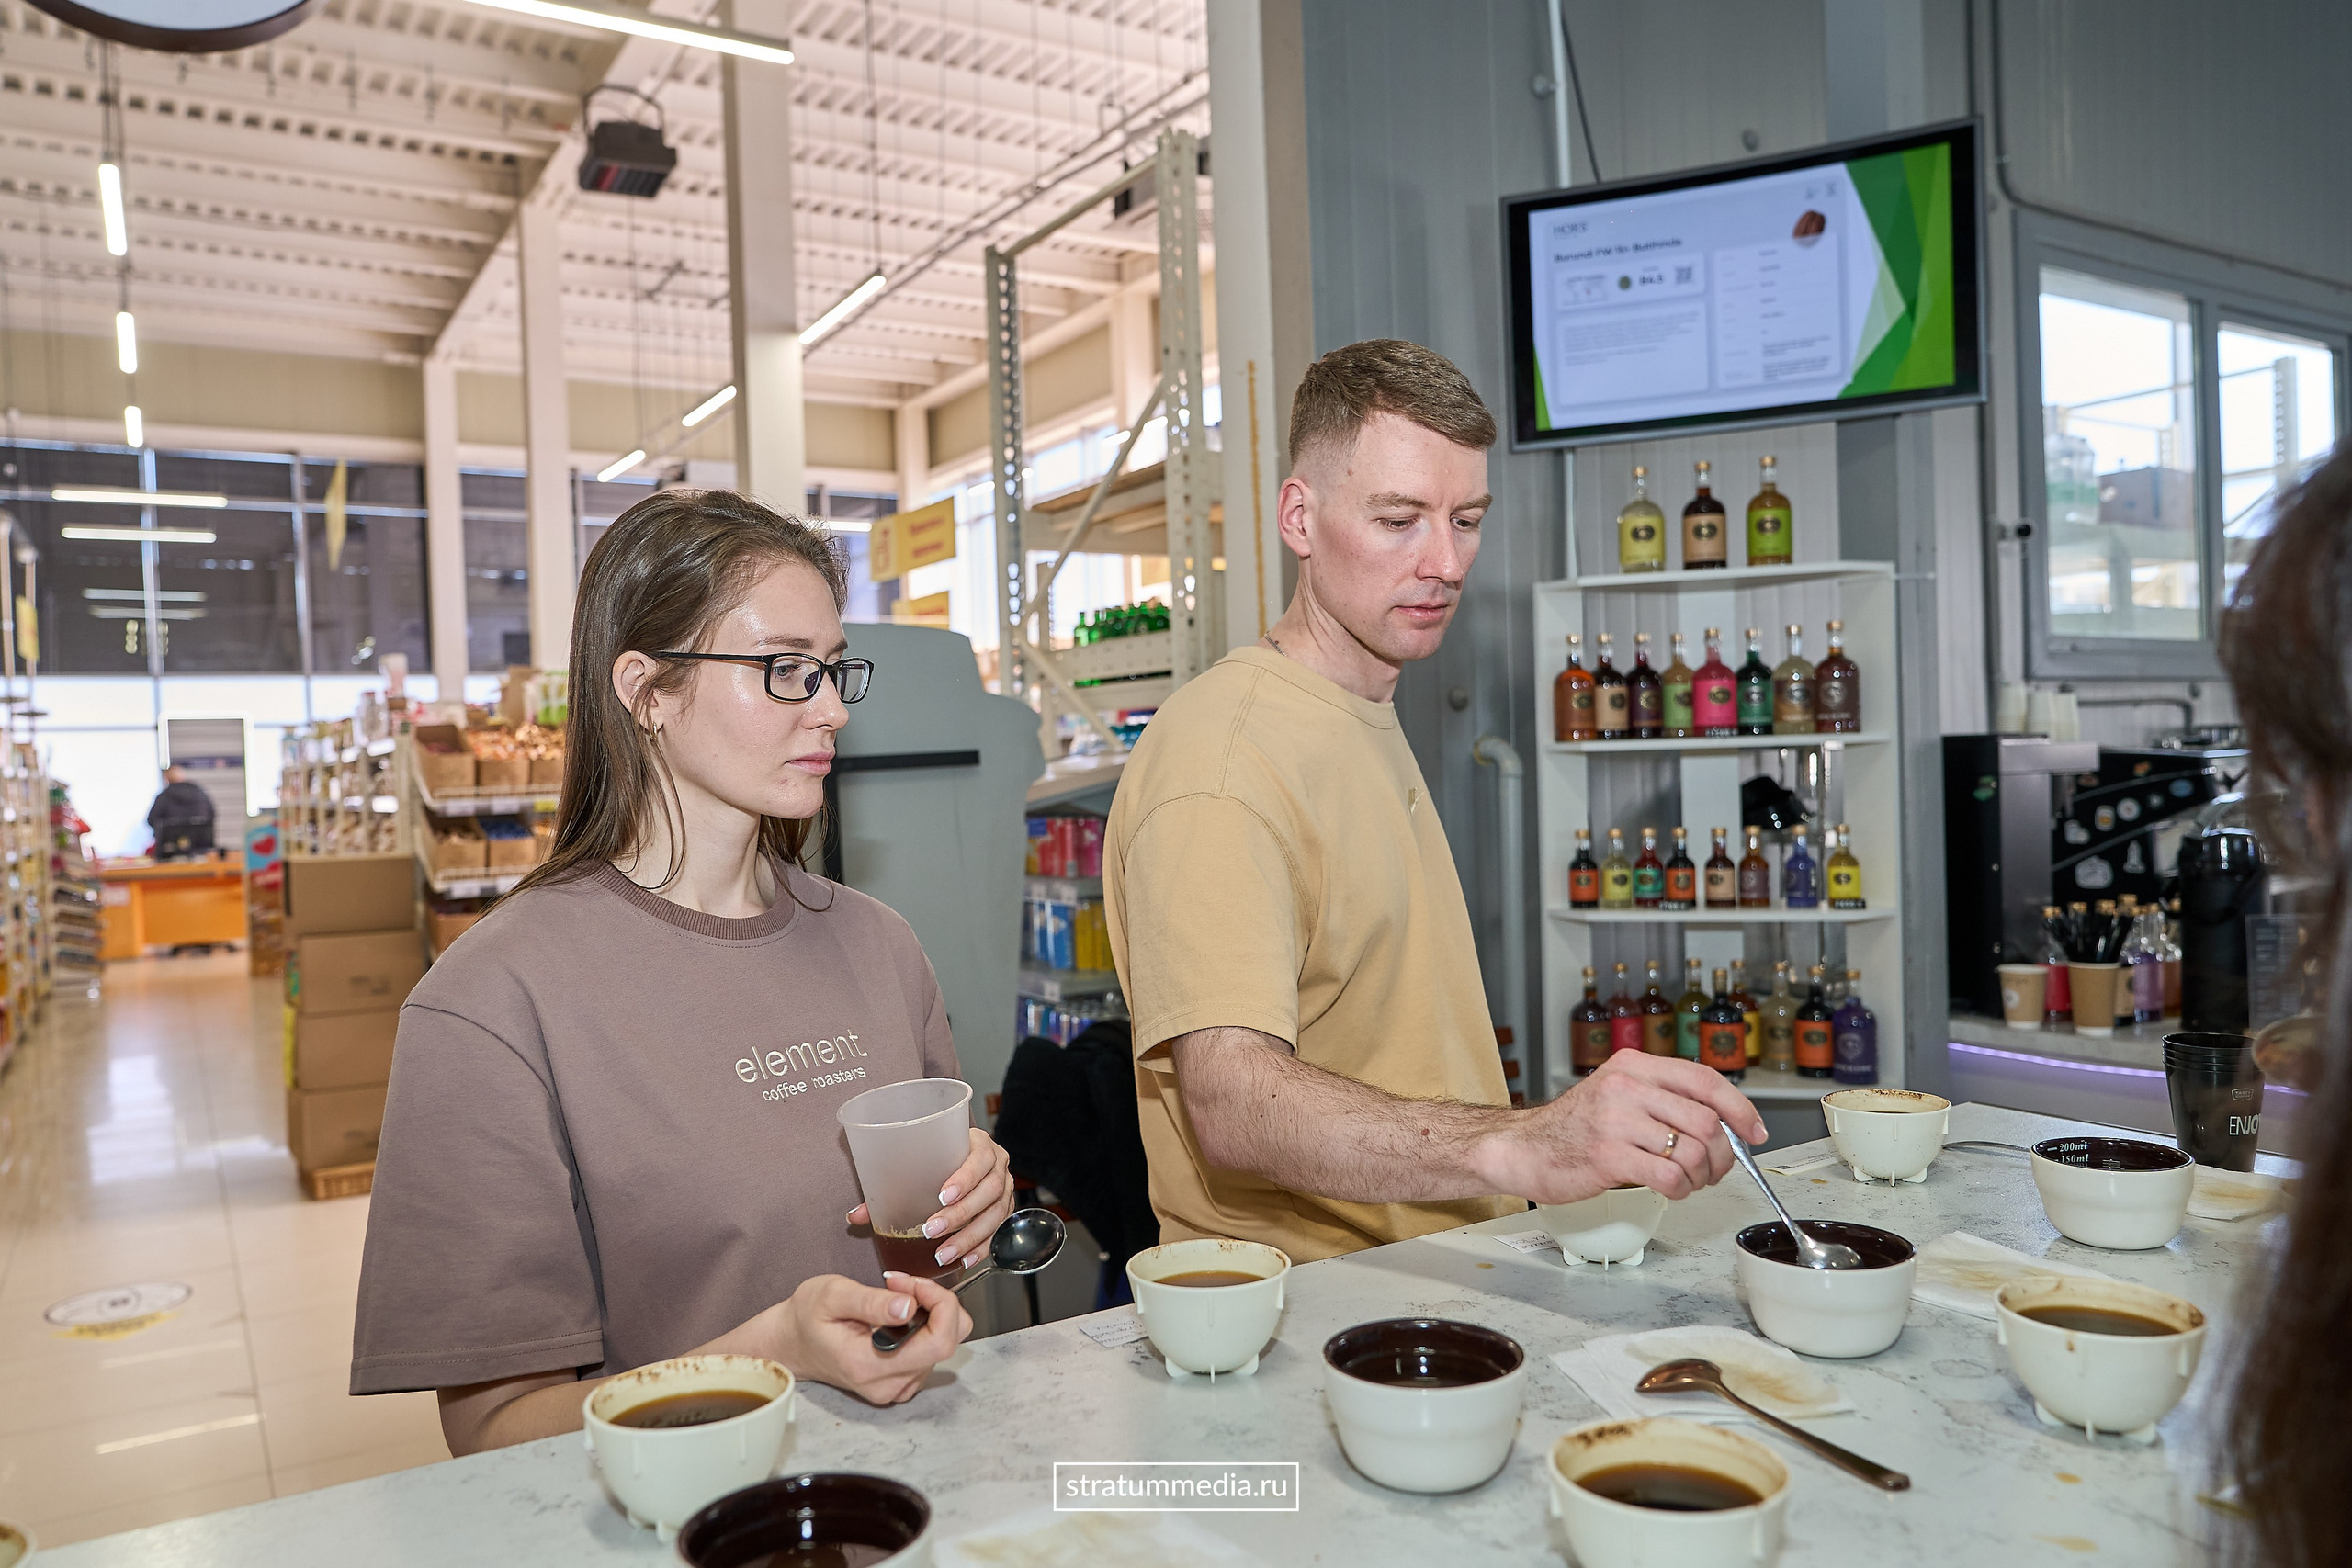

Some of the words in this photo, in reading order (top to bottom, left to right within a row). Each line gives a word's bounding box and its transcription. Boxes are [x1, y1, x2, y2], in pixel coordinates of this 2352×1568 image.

[735, 1028, 868, 1083] element
[763, 1081, 808, 1101] coffee
[811, 1066, 866, 1089] roasters
[2229, 1113, 2261, 1135] ENJO
[2059, 1141, 2088, 1153] 200ml
[2062, 1154, 2089, 1164] 150ml
